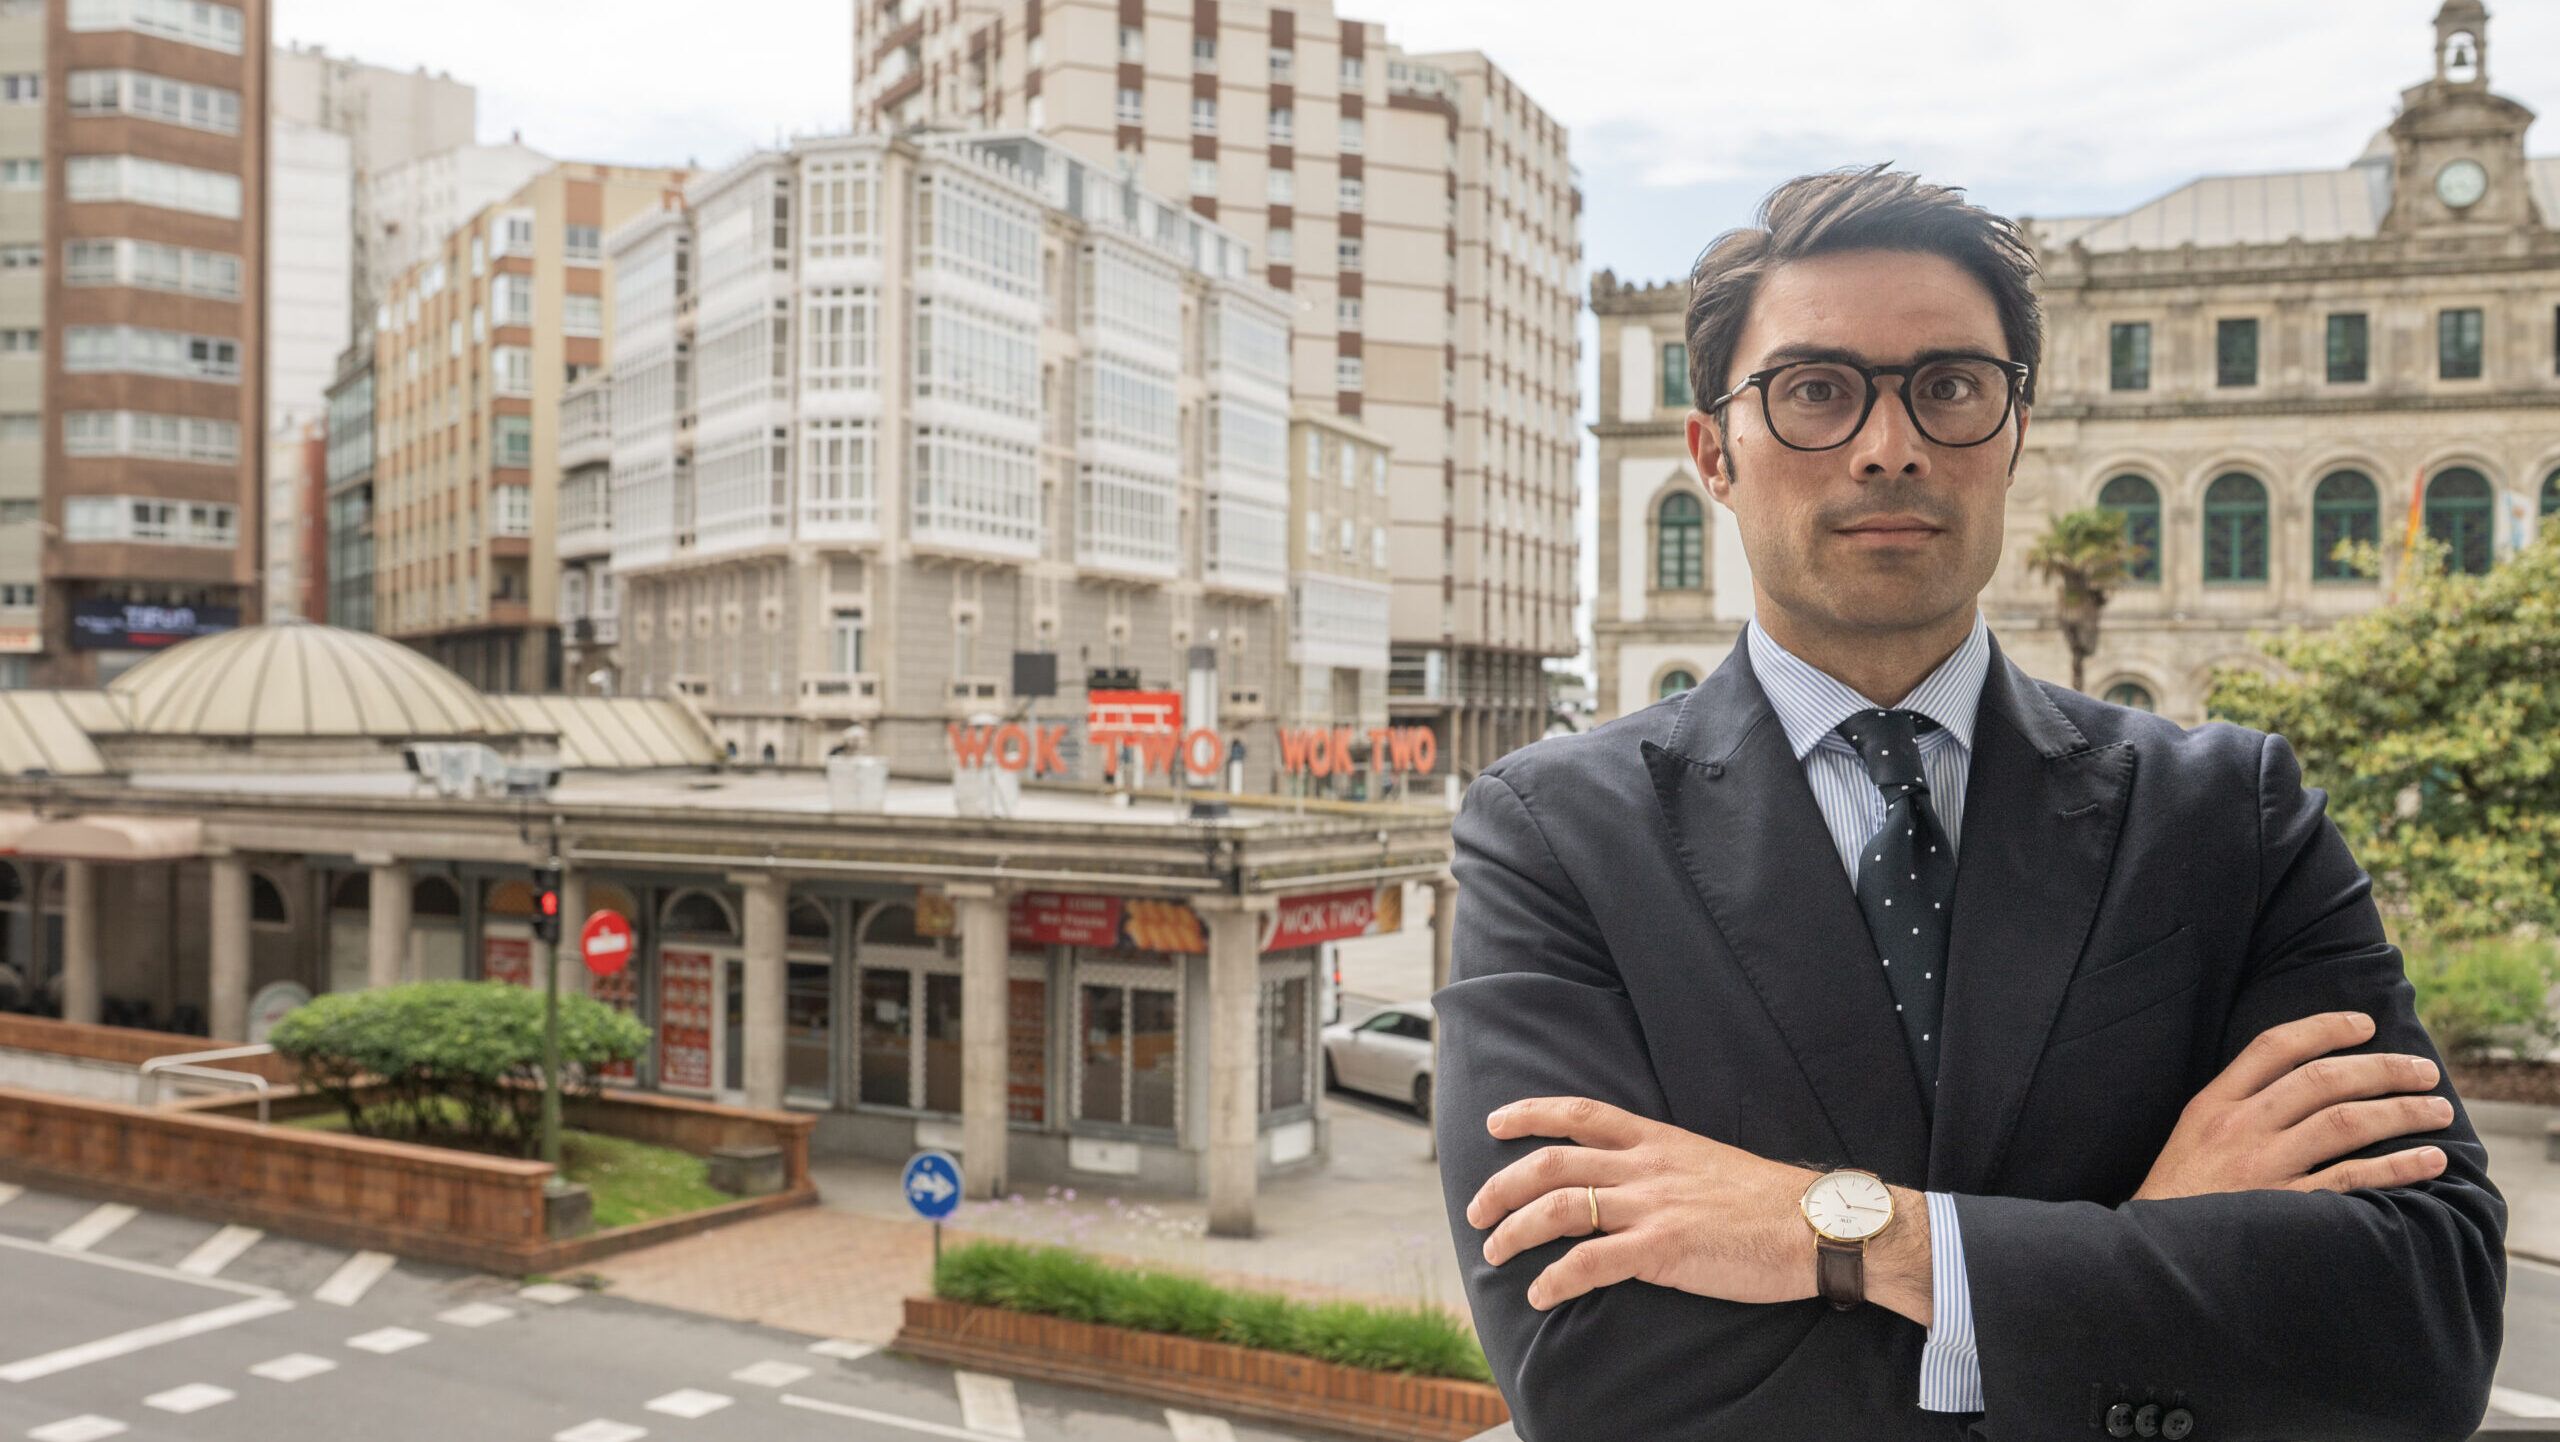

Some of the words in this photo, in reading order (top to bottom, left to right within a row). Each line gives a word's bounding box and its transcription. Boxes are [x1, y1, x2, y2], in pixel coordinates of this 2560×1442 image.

[947, 723, 1069, 775] WOK
[1090, 728, 1224, 776] TWO
[1279, 725, 1355, 778] WOK
[1368, 725, 1437, 775] TWO
[1282, 904, 1327, 935] WOK
[1328, 897, 1370, 929] TWO
